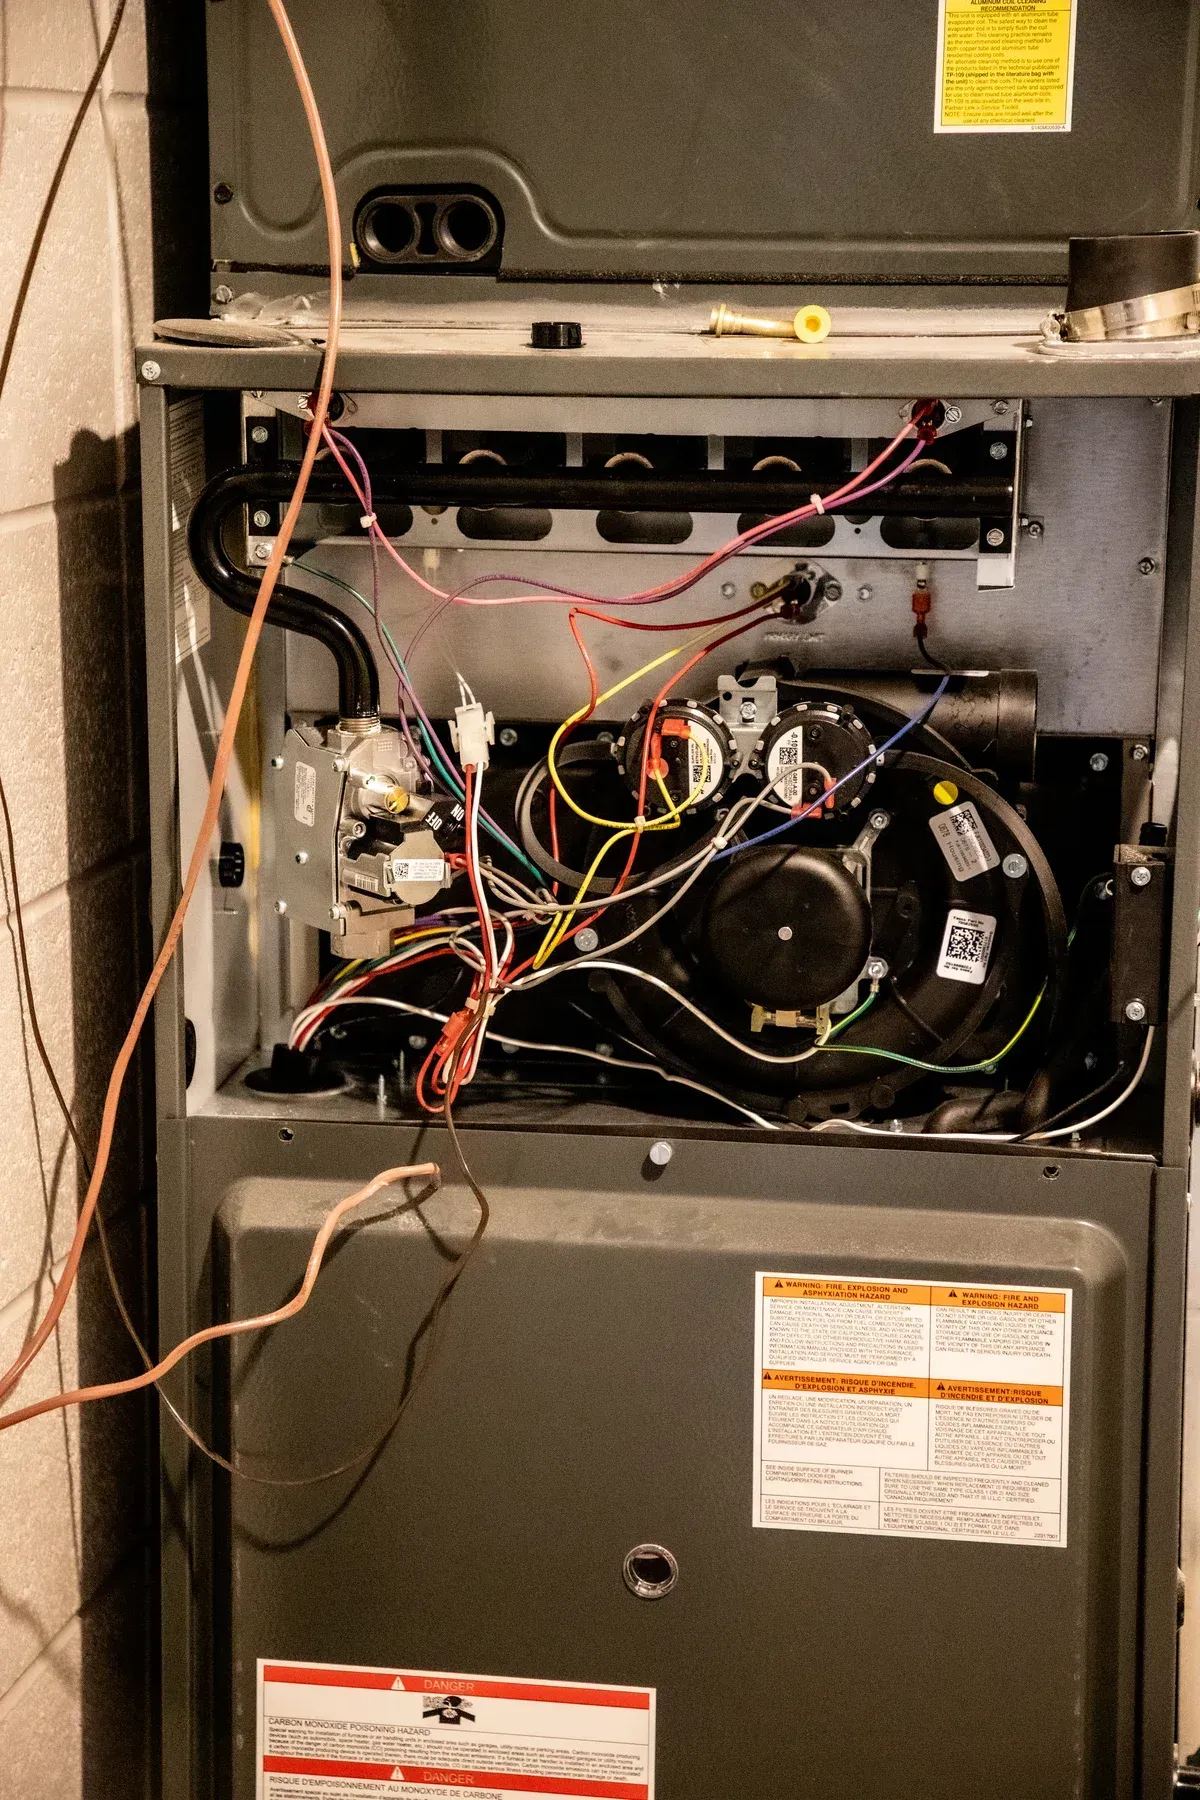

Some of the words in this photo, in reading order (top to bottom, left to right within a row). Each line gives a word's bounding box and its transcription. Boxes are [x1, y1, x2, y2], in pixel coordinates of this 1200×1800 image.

[450, 804, 464, 821] ON
[425, 811, 442, 830] OFF
[947, 842, 963, 872] Housing
[802, 1290, 858, 1298] ASPHYXIATION
[795, 1384, 845, 1392] D'EXPLOSION
[948, 1385, 1042, 1396] AVERTISSEMENT:RISQUE
[997, 1396, 1049, 1404] D'EXPLOSION
[424, 1680, 475, 1691] DANGER
[268, 1718, 303, 1727] CARBON
[304, 1721, 348, 1730] MONOXIDE
[350, 1724, 396, 1733] POISONING
[397, 1727, 430, 1736] HAZARD
[423, 1772, 474, 1784] DANGER
[302, 1779, 386, 1790] D'EMPOISONNEMENT
[401, 1786, 448, 1795] MONOXYDE
[463, 1790, 502, 1799] CARBONE
